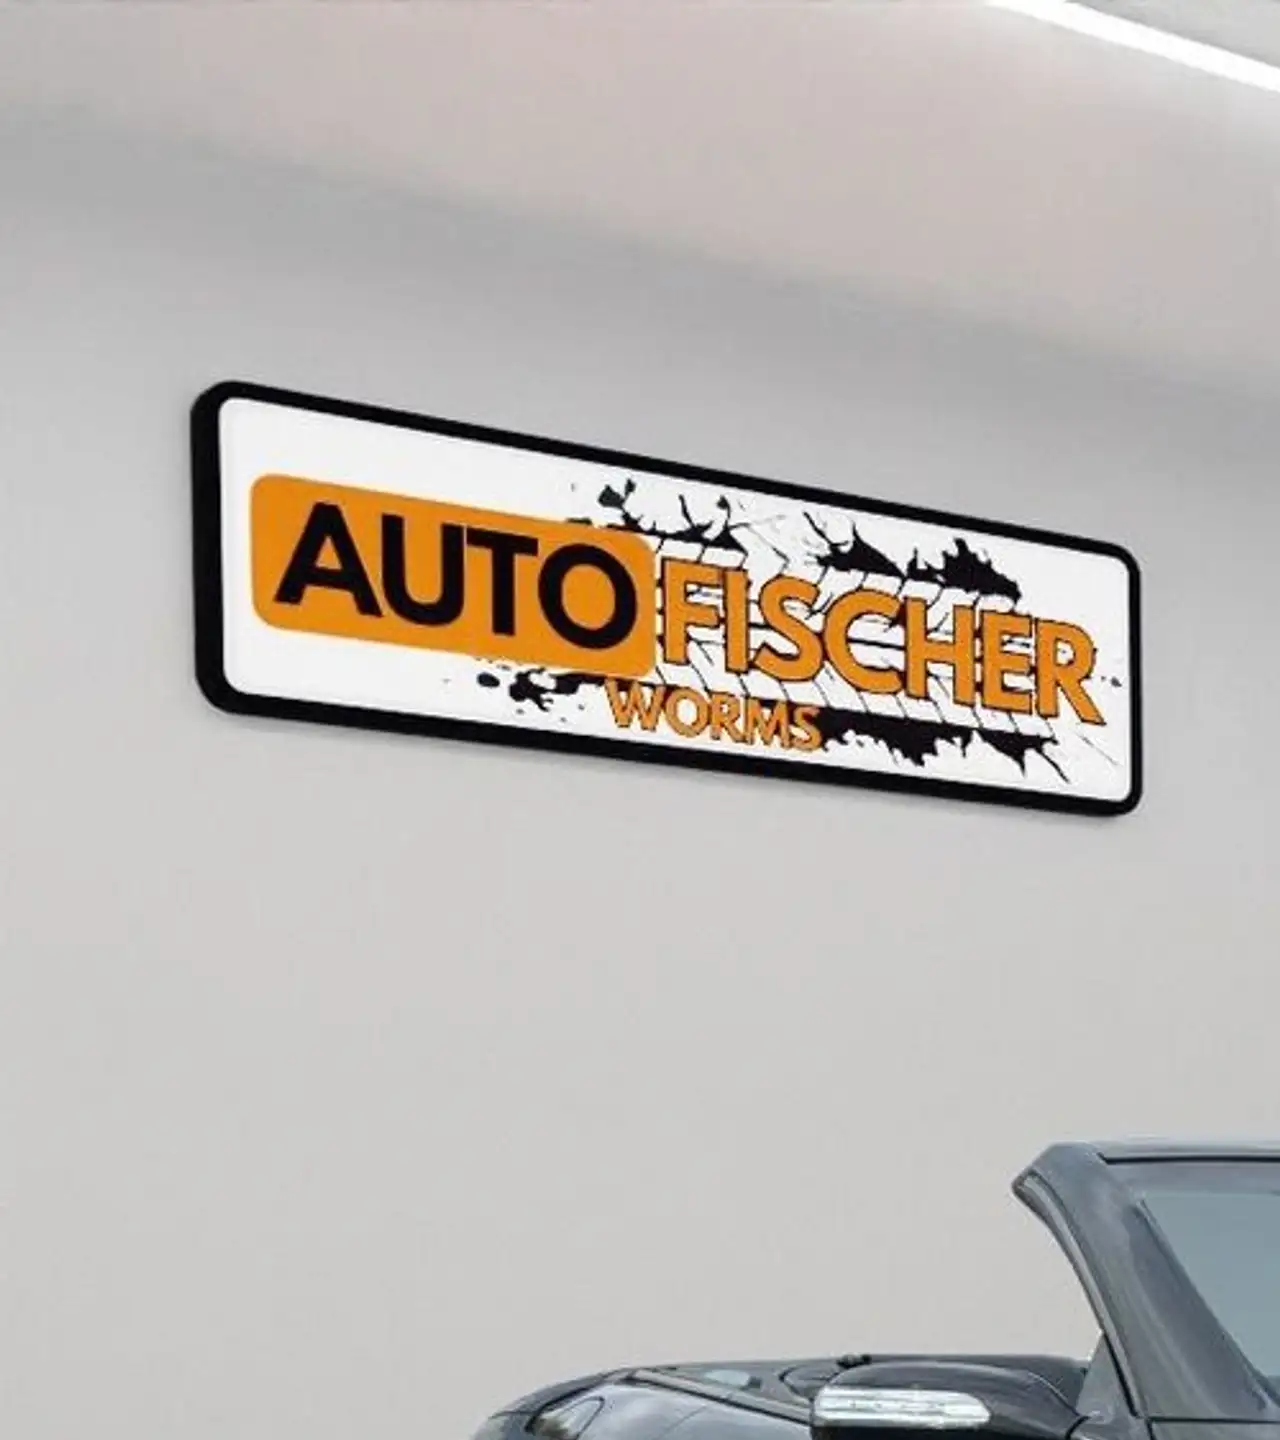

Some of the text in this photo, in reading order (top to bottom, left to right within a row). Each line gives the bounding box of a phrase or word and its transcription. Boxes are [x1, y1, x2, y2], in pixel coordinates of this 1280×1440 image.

[274, 501, 1107, 727] AUTO FISCHER
[603, 677, 824, 752] WORMS
